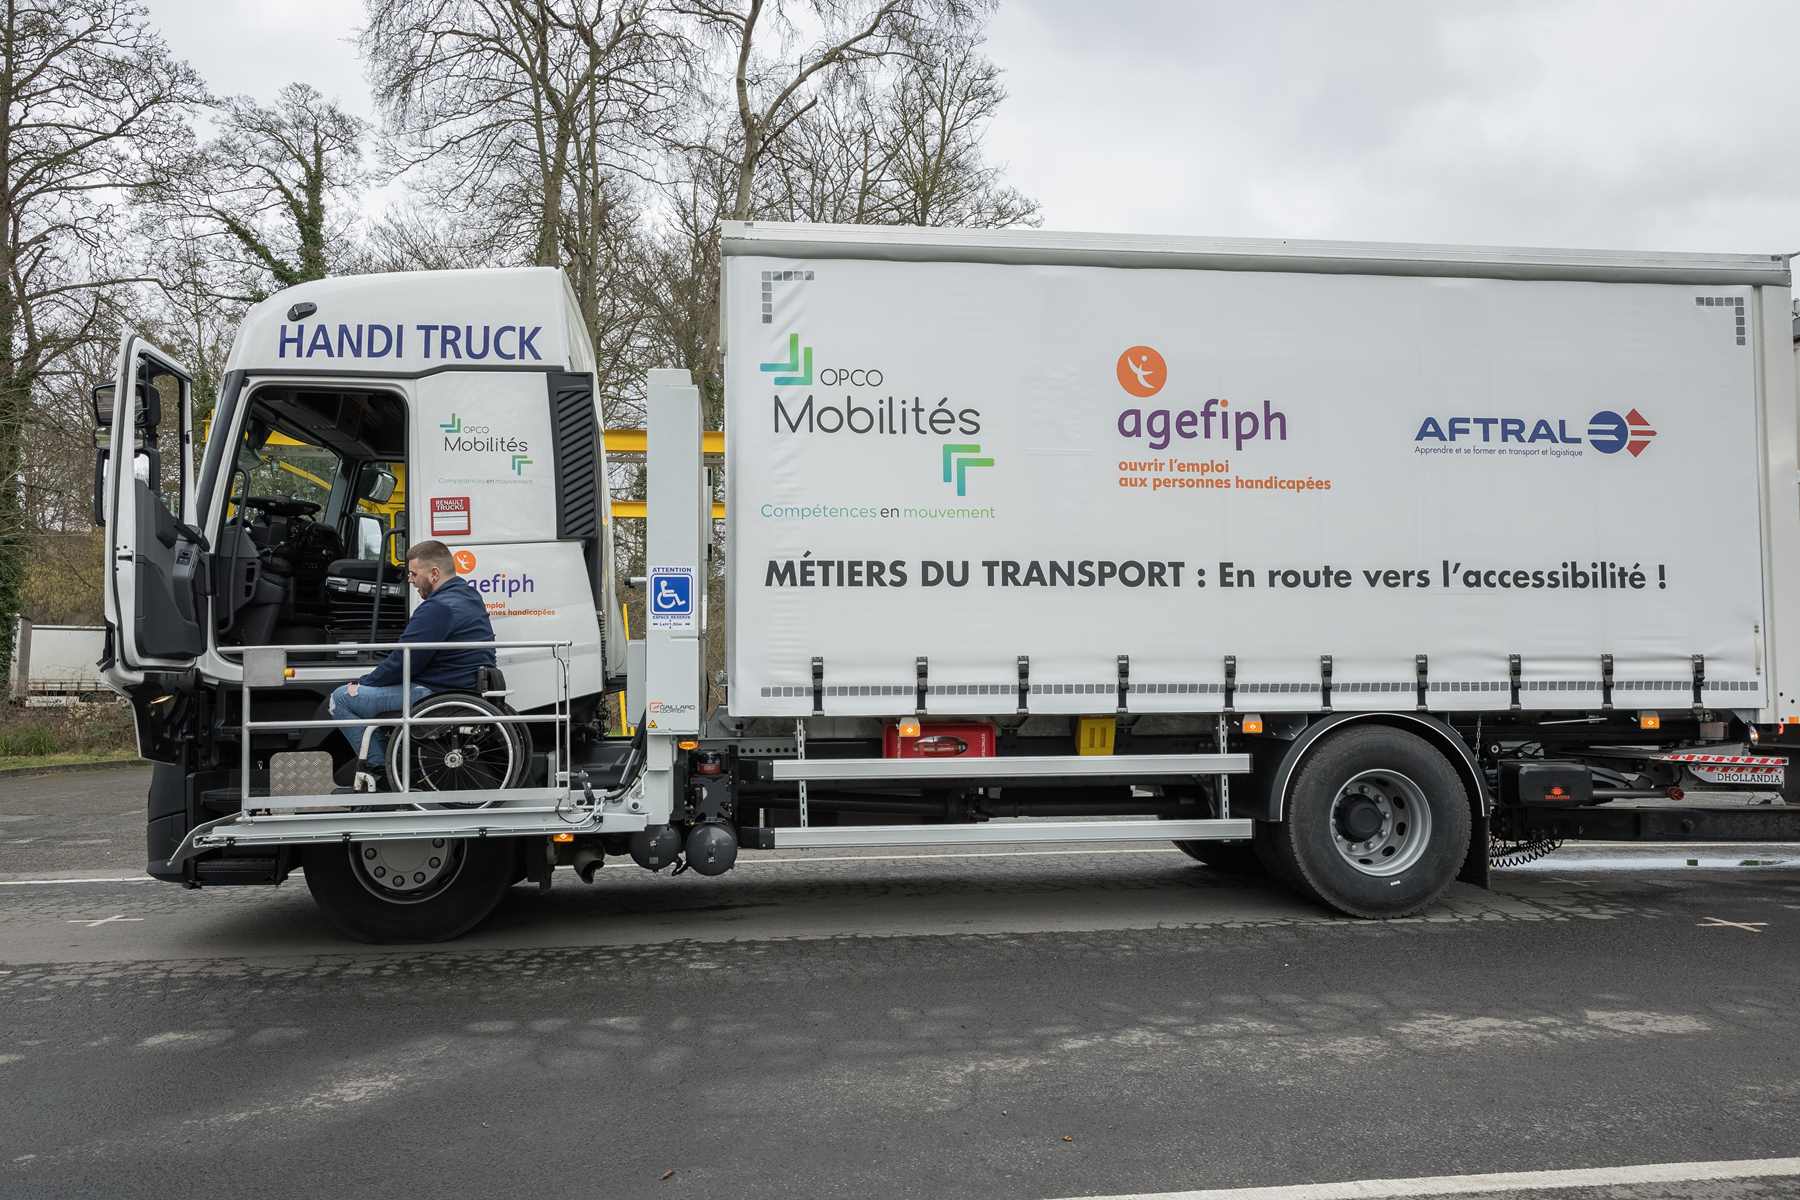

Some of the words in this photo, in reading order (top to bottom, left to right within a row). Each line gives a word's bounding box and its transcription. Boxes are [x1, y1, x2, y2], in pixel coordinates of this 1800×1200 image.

[279, 324, 404, 359] HANDI
[416, 325, 543, 361] TRUCK
[820, 368, 884, 387] OPCO
[773, 394, 982, 436] Mobilités
[463, 426, 490, 434] OPCO
[1117, 398, 1288, 451] agefiph
[1414, 416, 1583, 444] AFTRAL
[444, 436, 529, 453] Mobilités
[1415, 445, 1454, 455] Apprendre
[1473, 446, 1496, 456] former
[1509, 447, 1540, 457] transport
[1541, 448, 1549, 456] et
[1550, 447, 1584, 458] logistique
[1118, 458, 1166, 472] ouvrir
[1119, 475, 1148, 488] aux
[1152, 476, 1231, 491] personnes
[1235, 475, 1332, 493] handicapées
[760, 504, 878, 520] Compétences
[880, 505, 900, 519] en
[904, 505, 997, 519] mouvement
[765, 550, 908, 587] MÉTIERS
[921, 560, 969, 587] DU
[981, 560, 1185, 588] TRANSPORT
[1219, 562, 1255, 588] En
[1268, 565, 1352, 589] route
[1363, 569, 1431, 589] vers
[1657, 564, 1666, 590] !
[467, 574, 535, 598] gefiph
[1717, 773, 1781, 783] DHOLLANDIA
